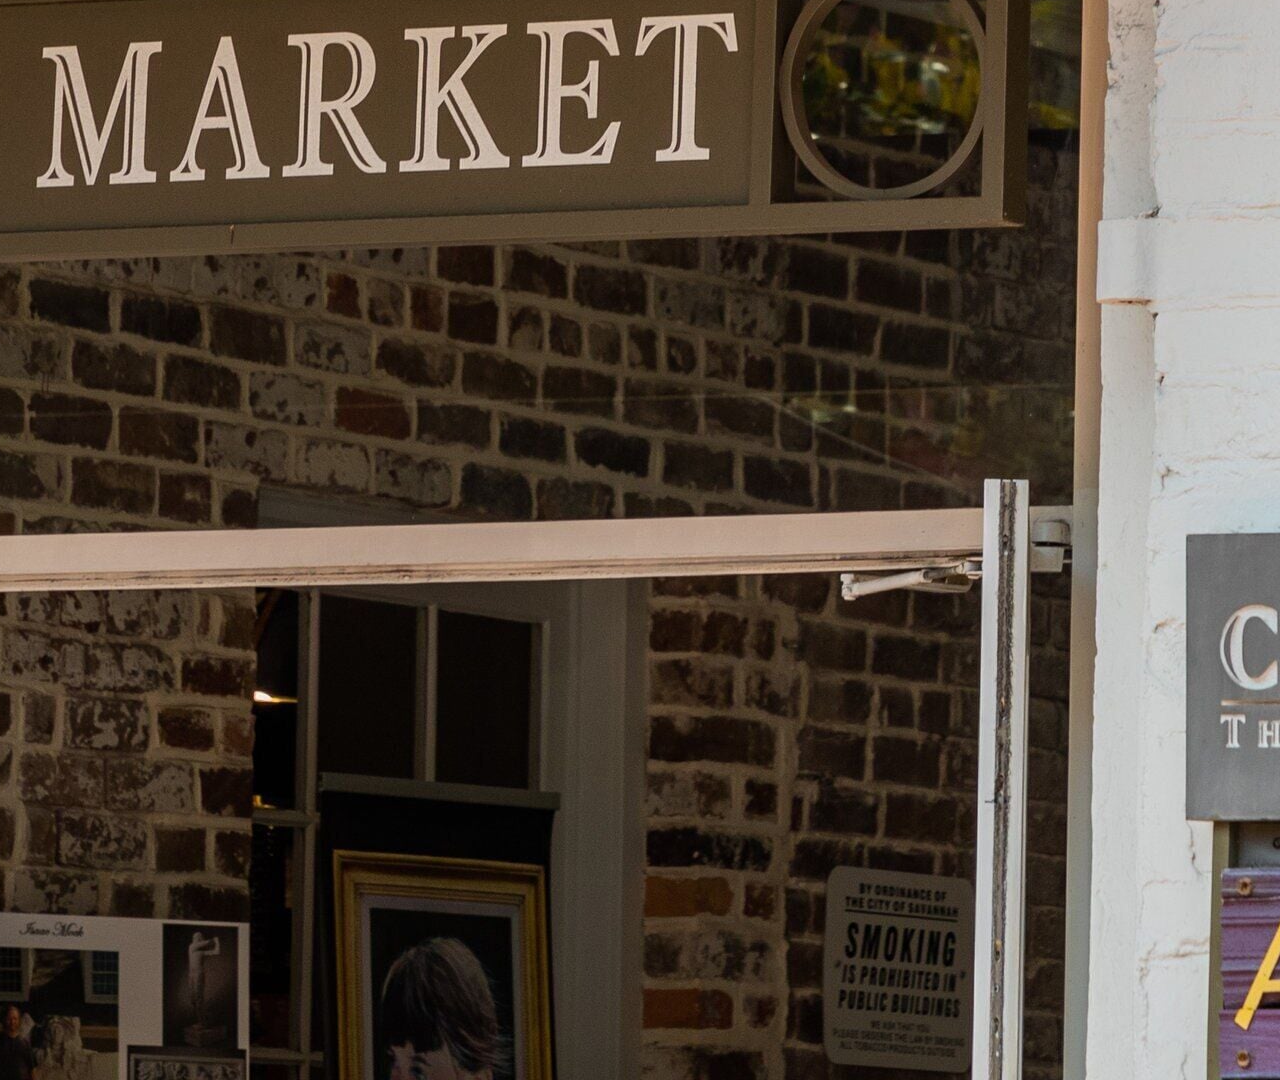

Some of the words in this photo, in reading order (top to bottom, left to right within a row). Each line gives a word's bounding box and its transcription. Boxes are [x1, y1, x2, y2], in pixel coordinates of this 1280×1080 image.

[36, 12, 738, 189] MARKET
[859, 883, 873, 895] BY
[934, 890, 947, 902] OF
[845, 896, 865, 909] THE
[867, 899, 890, 911] CITY
[892, 901, 906, 912] OF
[908, 902, 959, 918] SAVANNAH
[845, 922, 957, 967] SMOKING
[841, 965, 856, 984] IS
[859, 966, 940, 991] PROHIBITED
[942, 973, 957, 992] IN
[837, 989, 888, 1012] PUBLIC
[890, 993, 960, 1018] BUILDINGS
